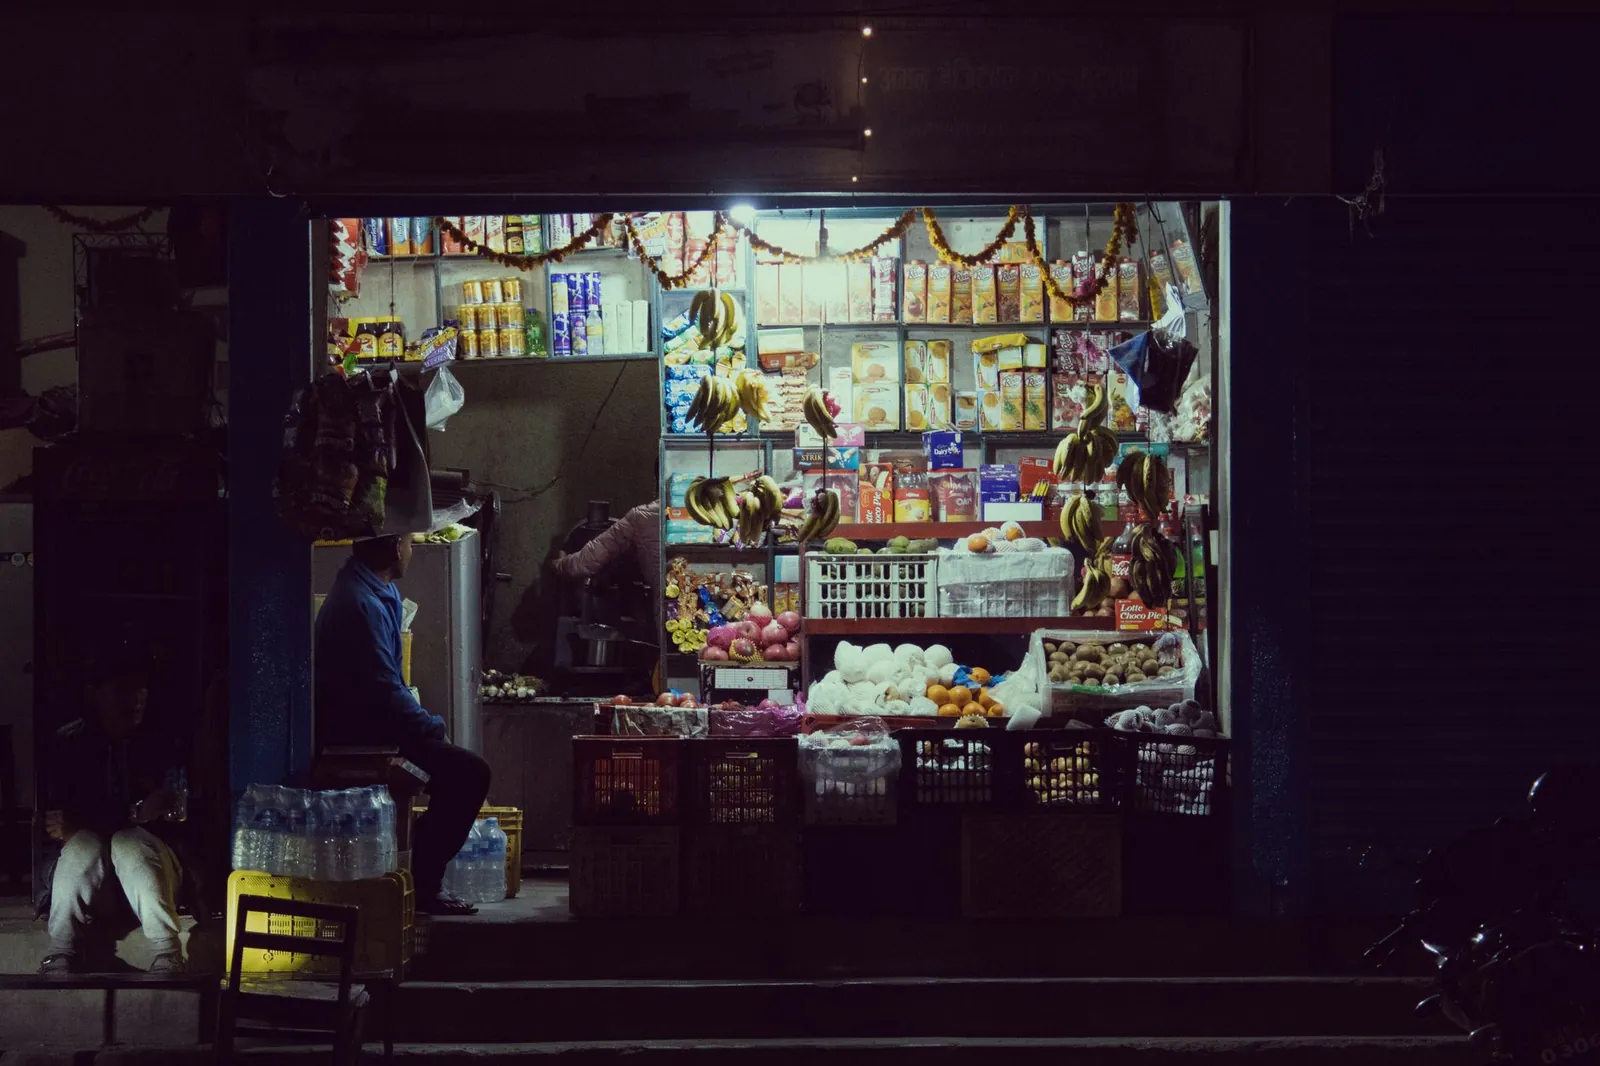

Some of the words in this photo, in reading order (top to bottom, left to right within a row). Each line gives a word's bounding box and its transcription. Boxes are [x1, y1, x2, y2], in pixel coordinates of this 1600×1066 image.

[934, 448, 948, 456] Dairy
[801, 453, 824, 461] STRIK
[1120, 604, 1143, 612] Lotte
[1120, 611, 1146, 620] Choco
[1146, 611, 1162, 620] Pie
